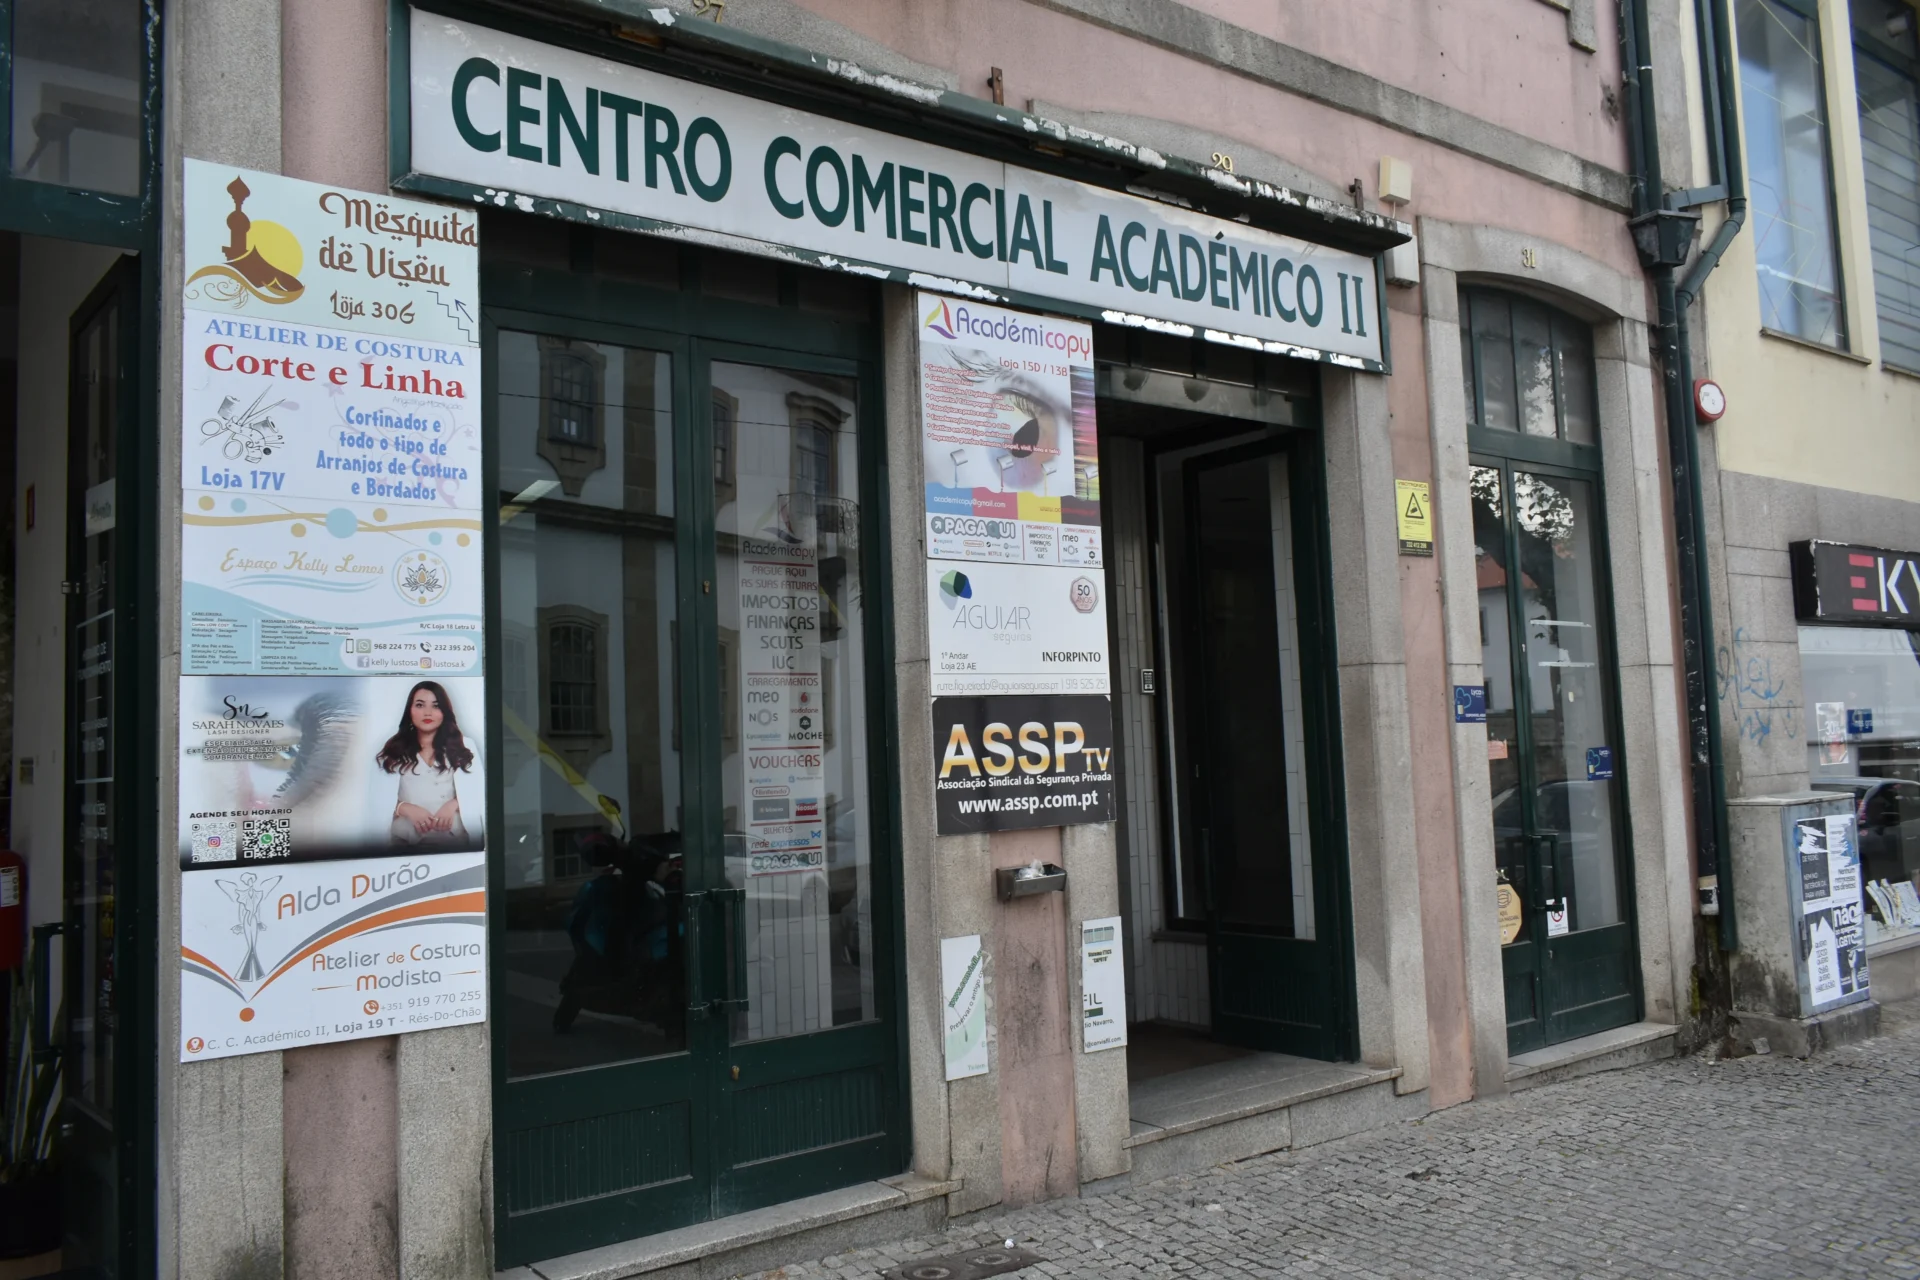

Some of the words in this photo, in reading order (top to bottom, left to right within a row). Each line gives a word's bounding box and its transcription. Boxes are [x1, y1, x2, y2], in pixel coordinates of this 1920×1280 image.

[451, 57, 733, 203] CENTRO
[763, 135, 1068, 276] COMERCIAL
[1090, 214, 1323, 328] ACADÉMICO
[1337, 272, 1367, 339] II
[1522, 247, 1536, 269] 31
[956, 306, 1091, 361] Académicopy
[205, 318, 309, 347] ATELIER
[315, 332, 348, 352] DE
[354, 338, 465, 367] COSTURA
[204, 343, 316, 382] Corte
[328, 365, 348, 386] e
[360, 361, 465, 400] Linha
[999, 356, 1019, 370] Loja
[1022, 360, 1041, 373] 15D
[1049, 363, 1068, 377] 13B
[345, 405, 429, 433] Cortinados
[432, 419, 442, 434] e
[339, 431, 375, 450] todo
[379, 438, 389, 451] o
[393, 434, 424, 456] tipo
[429, 438, 447, 457] de
[315, 449, 383, 476] Arranjos
[387, 456, 406, 476] de
[411, 458, 468, 482] Costura
[201, 465, 243, 491] Loja
[249, 468, 286, 492] 17V
[350, 482, 361, 496] e
[366, 477, 437, 501] Bordados
[944, 516, 1016, 540] PAGAQUI
[1061, 533, 1079, 543] meo
[742, 540, 816, 560] Académicopy
[219, 547, 278, 574] Espaço
[283, 551, 329, 576] Kelly
[334, 553, 385, 576] Lemos
[752, 565, 783, 575] PAGUE
[785, 567, 807, 578] AQUI
[741, 578, 753, 588] AS
[756, 579, 779, 589] SUAS
[781, 581, 818, 591] FATURAS
[1077, 584, 1091, 597] 50
[742, 594, 818, 611] IMPOSTOS
[1076, 596, 1093, 604] ANOS
[746, 615, 815, 634] FINANÇAS
[952, 603, 1032, 630] AGUIAR
[432, 623, 445, 631] Loja
[760, 635, 804, 650] SCUTS
[993, 632, 1032, 645] seguros
[404, 643, 417, 651] 775
[371, 658, 389, 668] kelly
[391, 658, 419, 667] lustosa
[771, 655, 795, 670] IUC
[949, 651, 969, 661] Andar
[1042, 651, 1102, 663] INFORPINTO
[433, 660, 466, 669] lustosa.k
[940, 662, 956, 671] Loja
[956, 662, 966, 670] 23
[966, 662, 977, 671] AE
[747, 677, 819, 687] CARREGAMENTOS
[1065, 678, 1078, 690] 919
[1080, 678, 1094, 690] 525
[747, 691, 780, 703] meo
[192, 720, 235, 730] SARAH
[236, 719, 284, 729] NOVAES
[788, 732, 823, 741] MOCHE
[938, 721, 1085, 779] ASSP
[1080, 747, 1111, 772] TV
[748, 754, 821, 769] VOUCHERS
[937, 776, 987, 790] Associação
[988, 774, 1022, 787] Sindical
[1024, 774, 1035, 786] da
[1036, 773, 1080, 786] Segurança
[1082, 771, 1112, 783] Privada
[755, 788, 787, 796] Nintendo
[958, 789, 1099, 815] www.assp.com.pt
[189, 811, 228, 819] AGENDE
[763, 826, 794, 835] BILHETES
[751, 839, 770, 849] rede
[770, 839, 810, 848] expressos
[762, 851, 822, 870] PAGAQUI
[277, 885, 341, 920] Alda
[352, 862, 431, 899] Durão
[312, 950, 381, 972] Atelier
[386, 951, 405, 965] de
[409, 941, 481, 962] Costura
[380, 1001, 403, 1012] +351
[407, 996, 430, 1009] 919
[435, 993, 456, 1006] 770
[460, 990, 481, 1003] 255
[949, 1005, 972, 1032] Preservar
[971, 980, 981, 1001] antigo
[207, 1039, 221, 1050] C.
[226, 1036, 239, 1048] C.
[244, 1028, 311, 1046] Académico
[316, 1025, 330, 1038] II,
[335, 1021, 363, 1034] Loja
[368, 1018, 384, 1030] 19
[388, 1017, 396, 1027] T
[409, 1006, 482, 1024] Rés-Do-Chão
[1092, 1018, 1114, 1027] Navarro,
